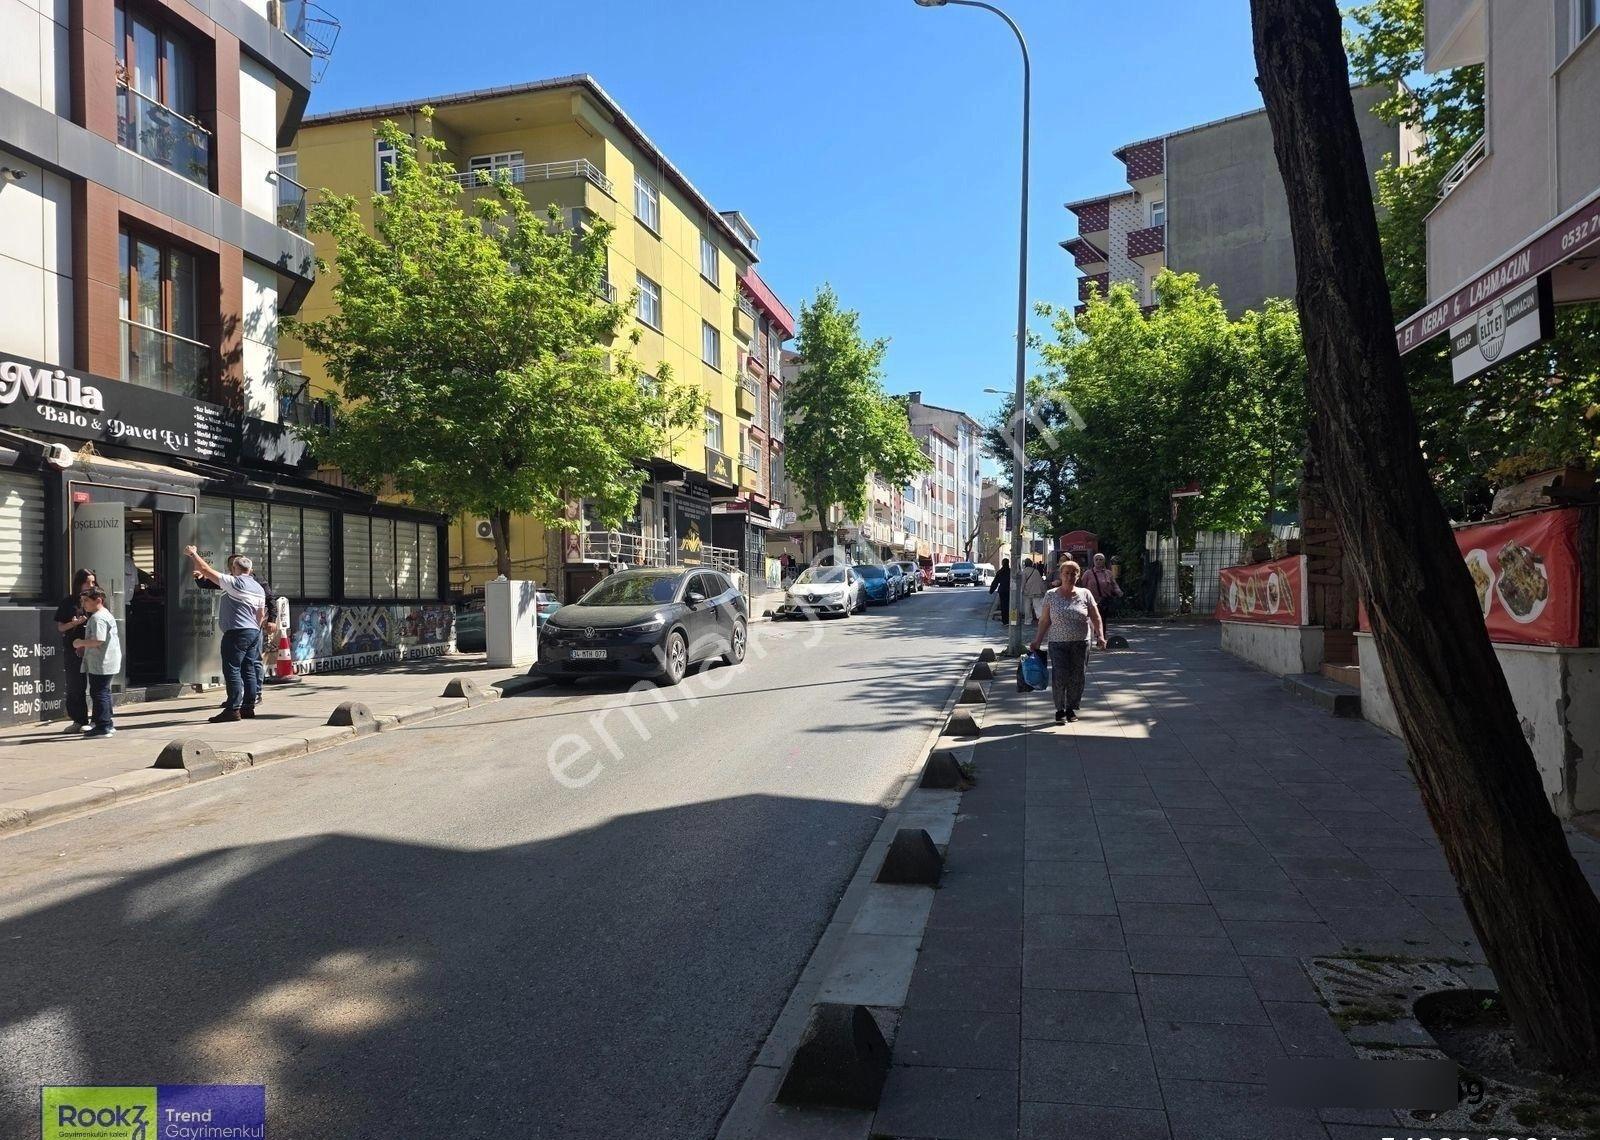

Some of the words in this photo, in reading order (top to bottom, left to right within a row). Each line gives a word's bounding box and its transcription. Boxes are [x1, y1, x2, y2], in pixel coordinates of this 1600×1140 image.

[1421, 303, 1449, 337] KEBAP
[1469, 249, 1532, 307] LAHMACUN
[1561, 221, 1589, 250] 0532
[1506, 293, 1535, 321] LAHMACUN
[1481, 319, 1494, 340] ELİT
[1495, 315, 1503, 332] ET
[1456, 334, 1472, 351] KEBAP
[0, 361, 105, 412] Mila
[36, 404, 87, 427] Balo
[91, 417, 102, 430] &
[107, 418, 158, 441] Davet
[160, 428, 189, 451] Evi
[74, 517, 120, 531] OŞGELDİNİZ
[13, 644, 29, 658] Söz
[34, 643, 56, 660] Nişan
[292, 655, 356, 675] ÜNLERİNİZİ
[358, 650, 408, 666] ORGANİZE
[410, 644, 451, 660] EDİYORUZ
[13, 663, 31, 677] Kına
[13, 681, 33, 696] Bride
[34, 680, 44, 693] To
[45, 680, 56, 693] Be
[13, 700, 33, 716] Baby
[34, 698, 62, 712] Shower
